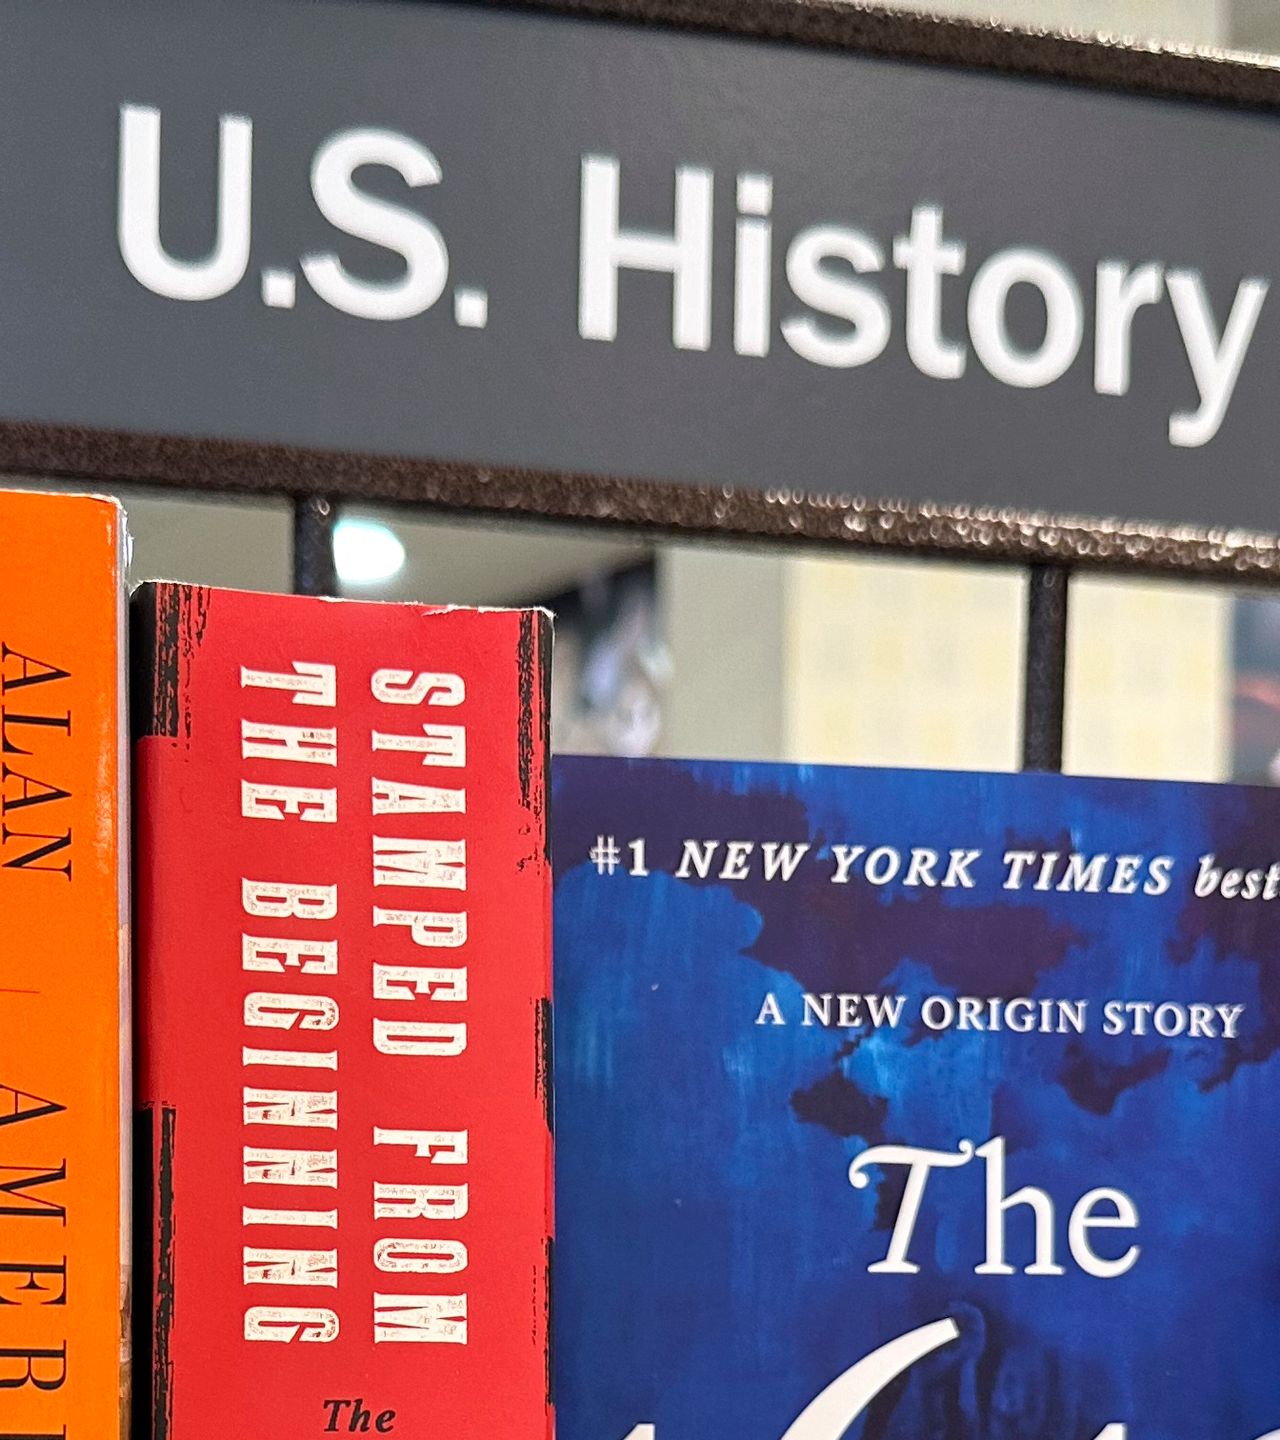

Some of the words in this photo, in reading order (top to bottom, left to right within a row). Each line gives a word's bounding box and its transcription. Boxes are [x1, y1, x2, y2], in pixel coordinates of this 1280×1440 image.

[117, 104, 489, 329] U.S.
[577, 153, 1271, 450] History
[0, 641, 73, 883] ALAN
[240, 659, 338, 824] THE
[370, 666, 469, 1057] STAMPED
[588, 833, 649, 878] #1
[675, 840, 808, 882] NEW
[829, 845, 981, 889] YORK
[1003, 850, 1173, 897] TIMES
[240, 876, 340, 1345] BEGINNING
[755, 992, 786, 1027] A
[801, 993, 906, 1030] NEW
[921, 996, 1087, 1035] ORIGIN
[1102, 1000, 1247, 1040] STORY
[372, 1127, 470, 1348] FROM
[847, 1137, 1142, 1279] The
[321, 1398, 396, 1434] The
